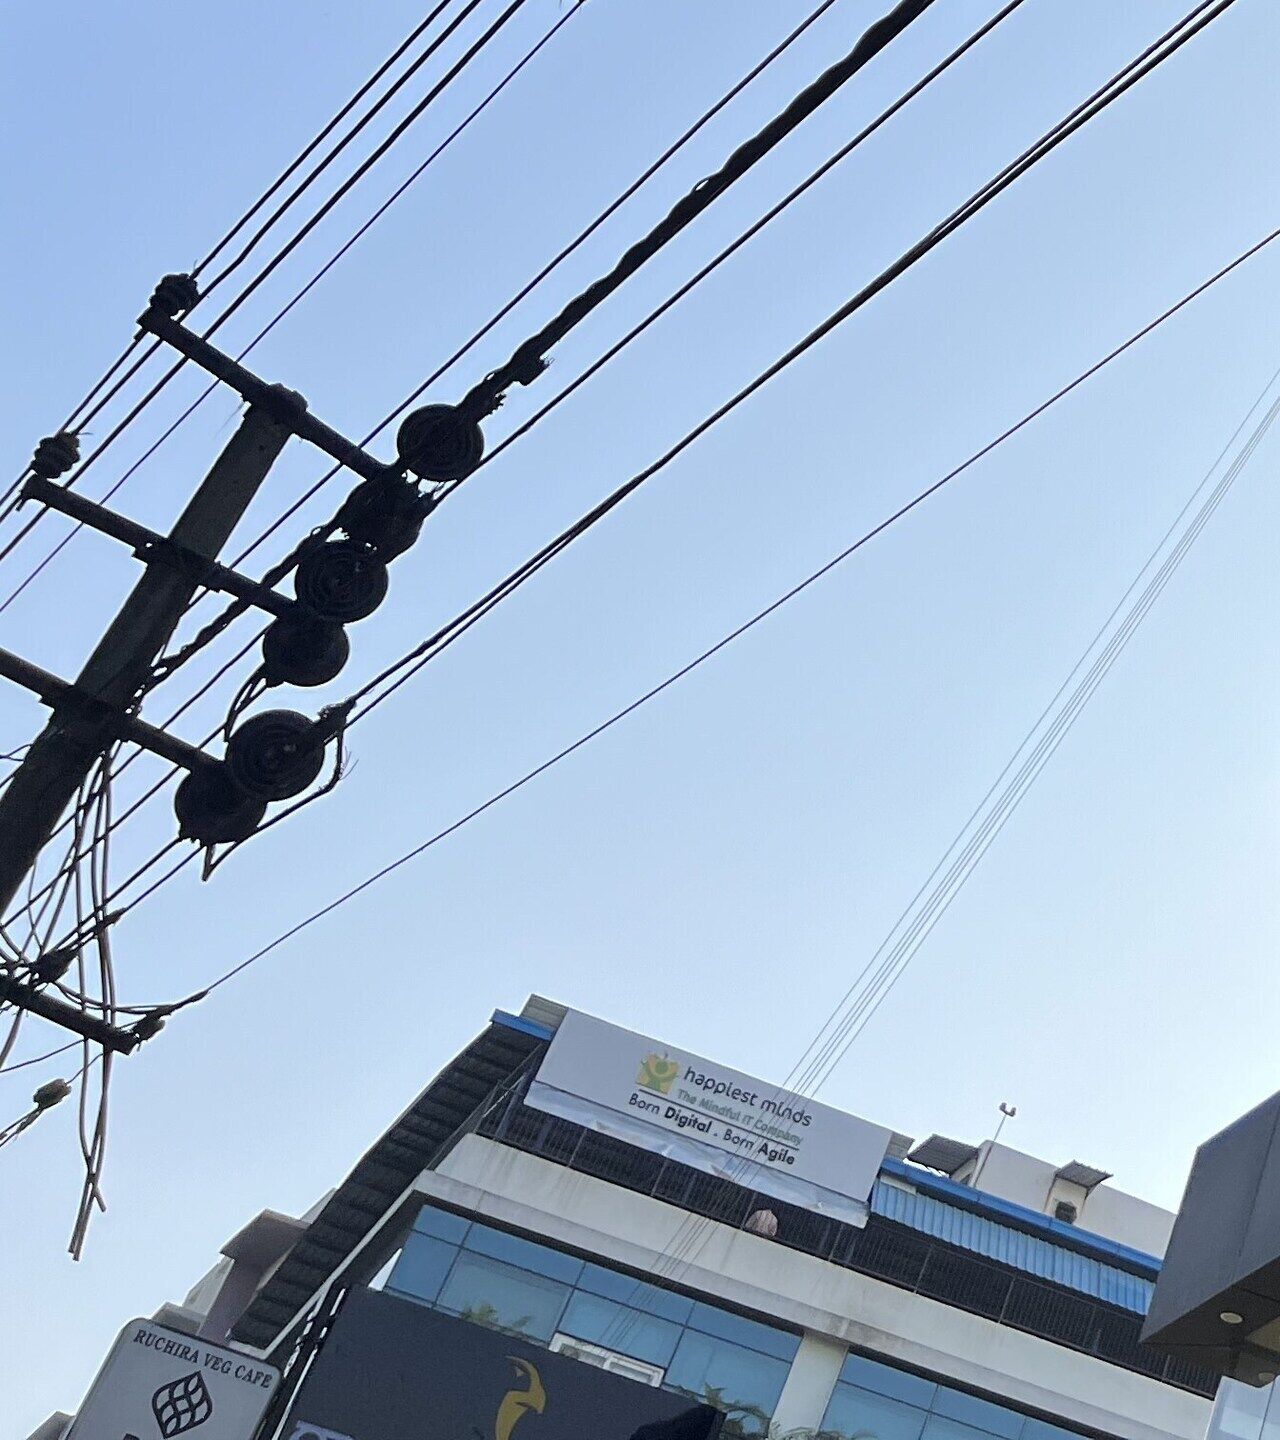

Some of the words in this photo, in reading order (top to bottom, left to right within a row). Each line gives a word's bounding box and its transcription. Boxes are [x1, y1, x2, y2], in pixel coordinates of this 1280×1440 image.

[677, 1088, 697, 1105] The
[684, 1067, 756, 1107] happiest
[761, 1098, 812, 1128] minds
[628, 1093, 661, 1116] Born
[664, 1105, 713, 1136] Digital
[723, 1128, 755, 1152] Born
[757, 1142, 796, 1166] Agile
[133, 1329, 200, 1363] RUCHIRA
[203, 1353, 232, 1375] VEG
[234, 1365, 273, 1389] CAFE
